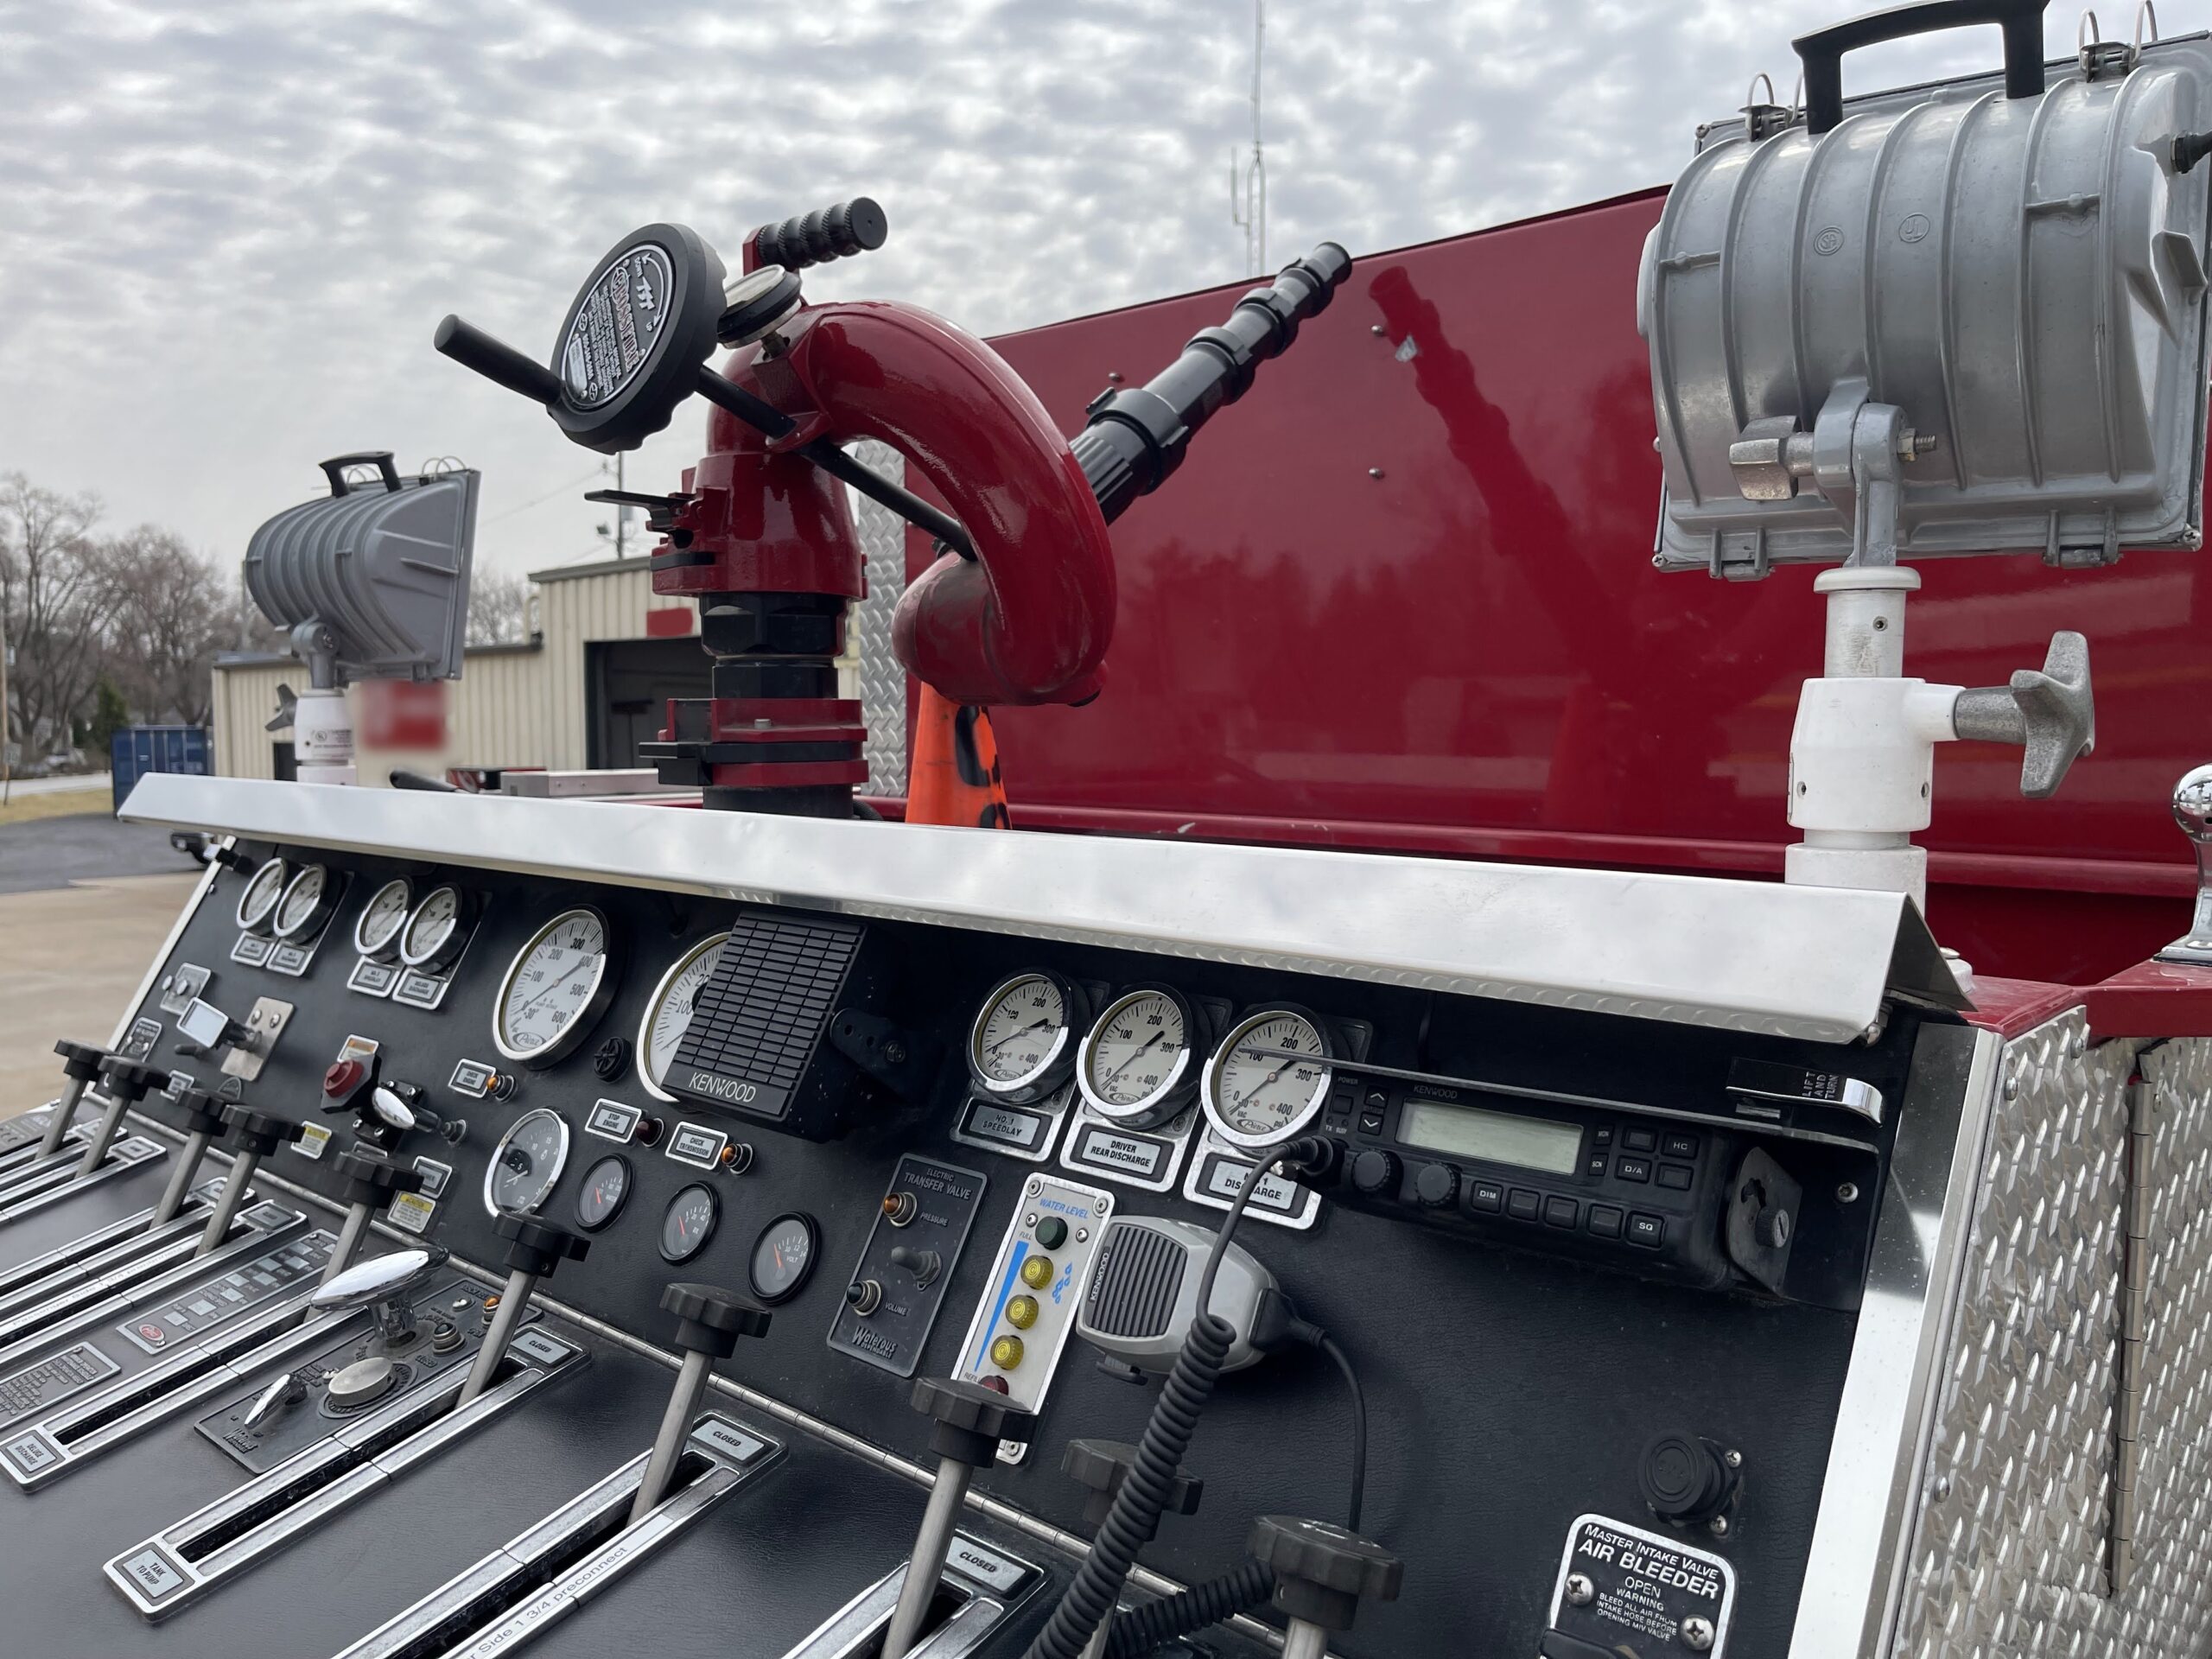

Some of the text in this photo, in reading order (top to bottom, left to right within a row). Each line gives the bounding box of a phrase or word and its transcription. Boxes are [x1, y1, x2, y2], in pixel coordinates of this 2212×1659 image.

[570, 938, 586, 950] 300
[548, 948, 563, 961] 200
[581, 956, 594, 968] 400
[530, 971, 544, 982] 100
[569, 984, 586, 996] 500
[676, 1000, 693, 1015] 100
[1032, 996, 1046, 1008] 200
[551, 1010, 567, 1024] 600
[1147, 1014, 1163, 1026] 200
[1042, 1024, 1056, 1034] 300
[1119, 1029, 1134, 1039] 100
[1160, 1042, 1175, 1053] 300
[1281, 1037, 1299, 1051] 200
[1025, 1052, 1039, 1064] 400
[1106, 1067, 1112, 1077] 0
[1295, 1068, 1313, 1082] 300
[689, 1071, 756, 1103] KENWOOD
[1143, 1074, 1159, 1086] 400
[1338, 1076, 1358, 1086] POWER
[1802, 1071, 1816, 1097] LIFT
[1814, 1074, 1827, 1098] AND
[1824, 1074, 1840, 1100] TURN
[1233, 1090, 1240, 1102] 0
[1413, 1084, 1458, 1099] KENWOOD
[1276, 1103, 1294, 1116] 400
[607, 1112, 620, 1122] STOP
[995, 1114, 1009, 1123] NO.
[982, 1121, 1023, 1137] SPEEDLAY
[690, 1137, 705, 1147] CHECK
[1110, 1140, 1137, 1154] DRIVER
[1673, 1141, 1688, 1151] HC
[1090, 1146, 1152, 1167] REAR DISCHARGE
[926, 1167, 954, 1182] ELECTRIC
[1624, 1164, 1643, 1175] D/A
[904, 1172, 972, 1200] TRANSFER VALVE
[1224, 1178, 1282, 1200] DISARGE
[1479, 1190, 1497, 1199] DIM
[1039, 1198, 1089, 1219] WATER LEVEL
[919, 1211, 949, 1227] PRESSURE
[1638, 1222, 1654, 1231] SQ
[1019, 1231, 1032, 1241] FULL
[1090, 1251, 1109, 1301] KENWOOD
[885, 1301, 906, 1317] VOLUME
[851, 1325, 898, 1353] Waterous
[528, 1340, 552, 1353] CLOSED
[713, 1431, 741, 1446] CLOSED
[1585, 1524, 1719, 1580] MASTER INTAKE VALVE
[137, 1565, 147, 1573] TO
[959, 1551, 997, 1573] CLOSED
[1578, 1538, 1719, 1599] AIR BLEEDER
[149, 1562, 167, 1577] TANK
[1624, 1576, 1662, 1599] OPEN
[478, 1629, 513, 1654] Side
[526, 1601, 554, 1619] 3/4
[553, 1546, 628, 1602] preconnect
[1599, 1592, 1624, 1607] BLEED
[1624, 1601, 1638, 1613] ALL
[1639, 1606, 1653, 1618] AIR
[1617, 1587, 1664, 1611] WARNING
[1597, 1600, 1677, 1636] INTAKE HOSE BEFORE
[1597, 1608, 1671, 1642] OPENING MIV VALVE
